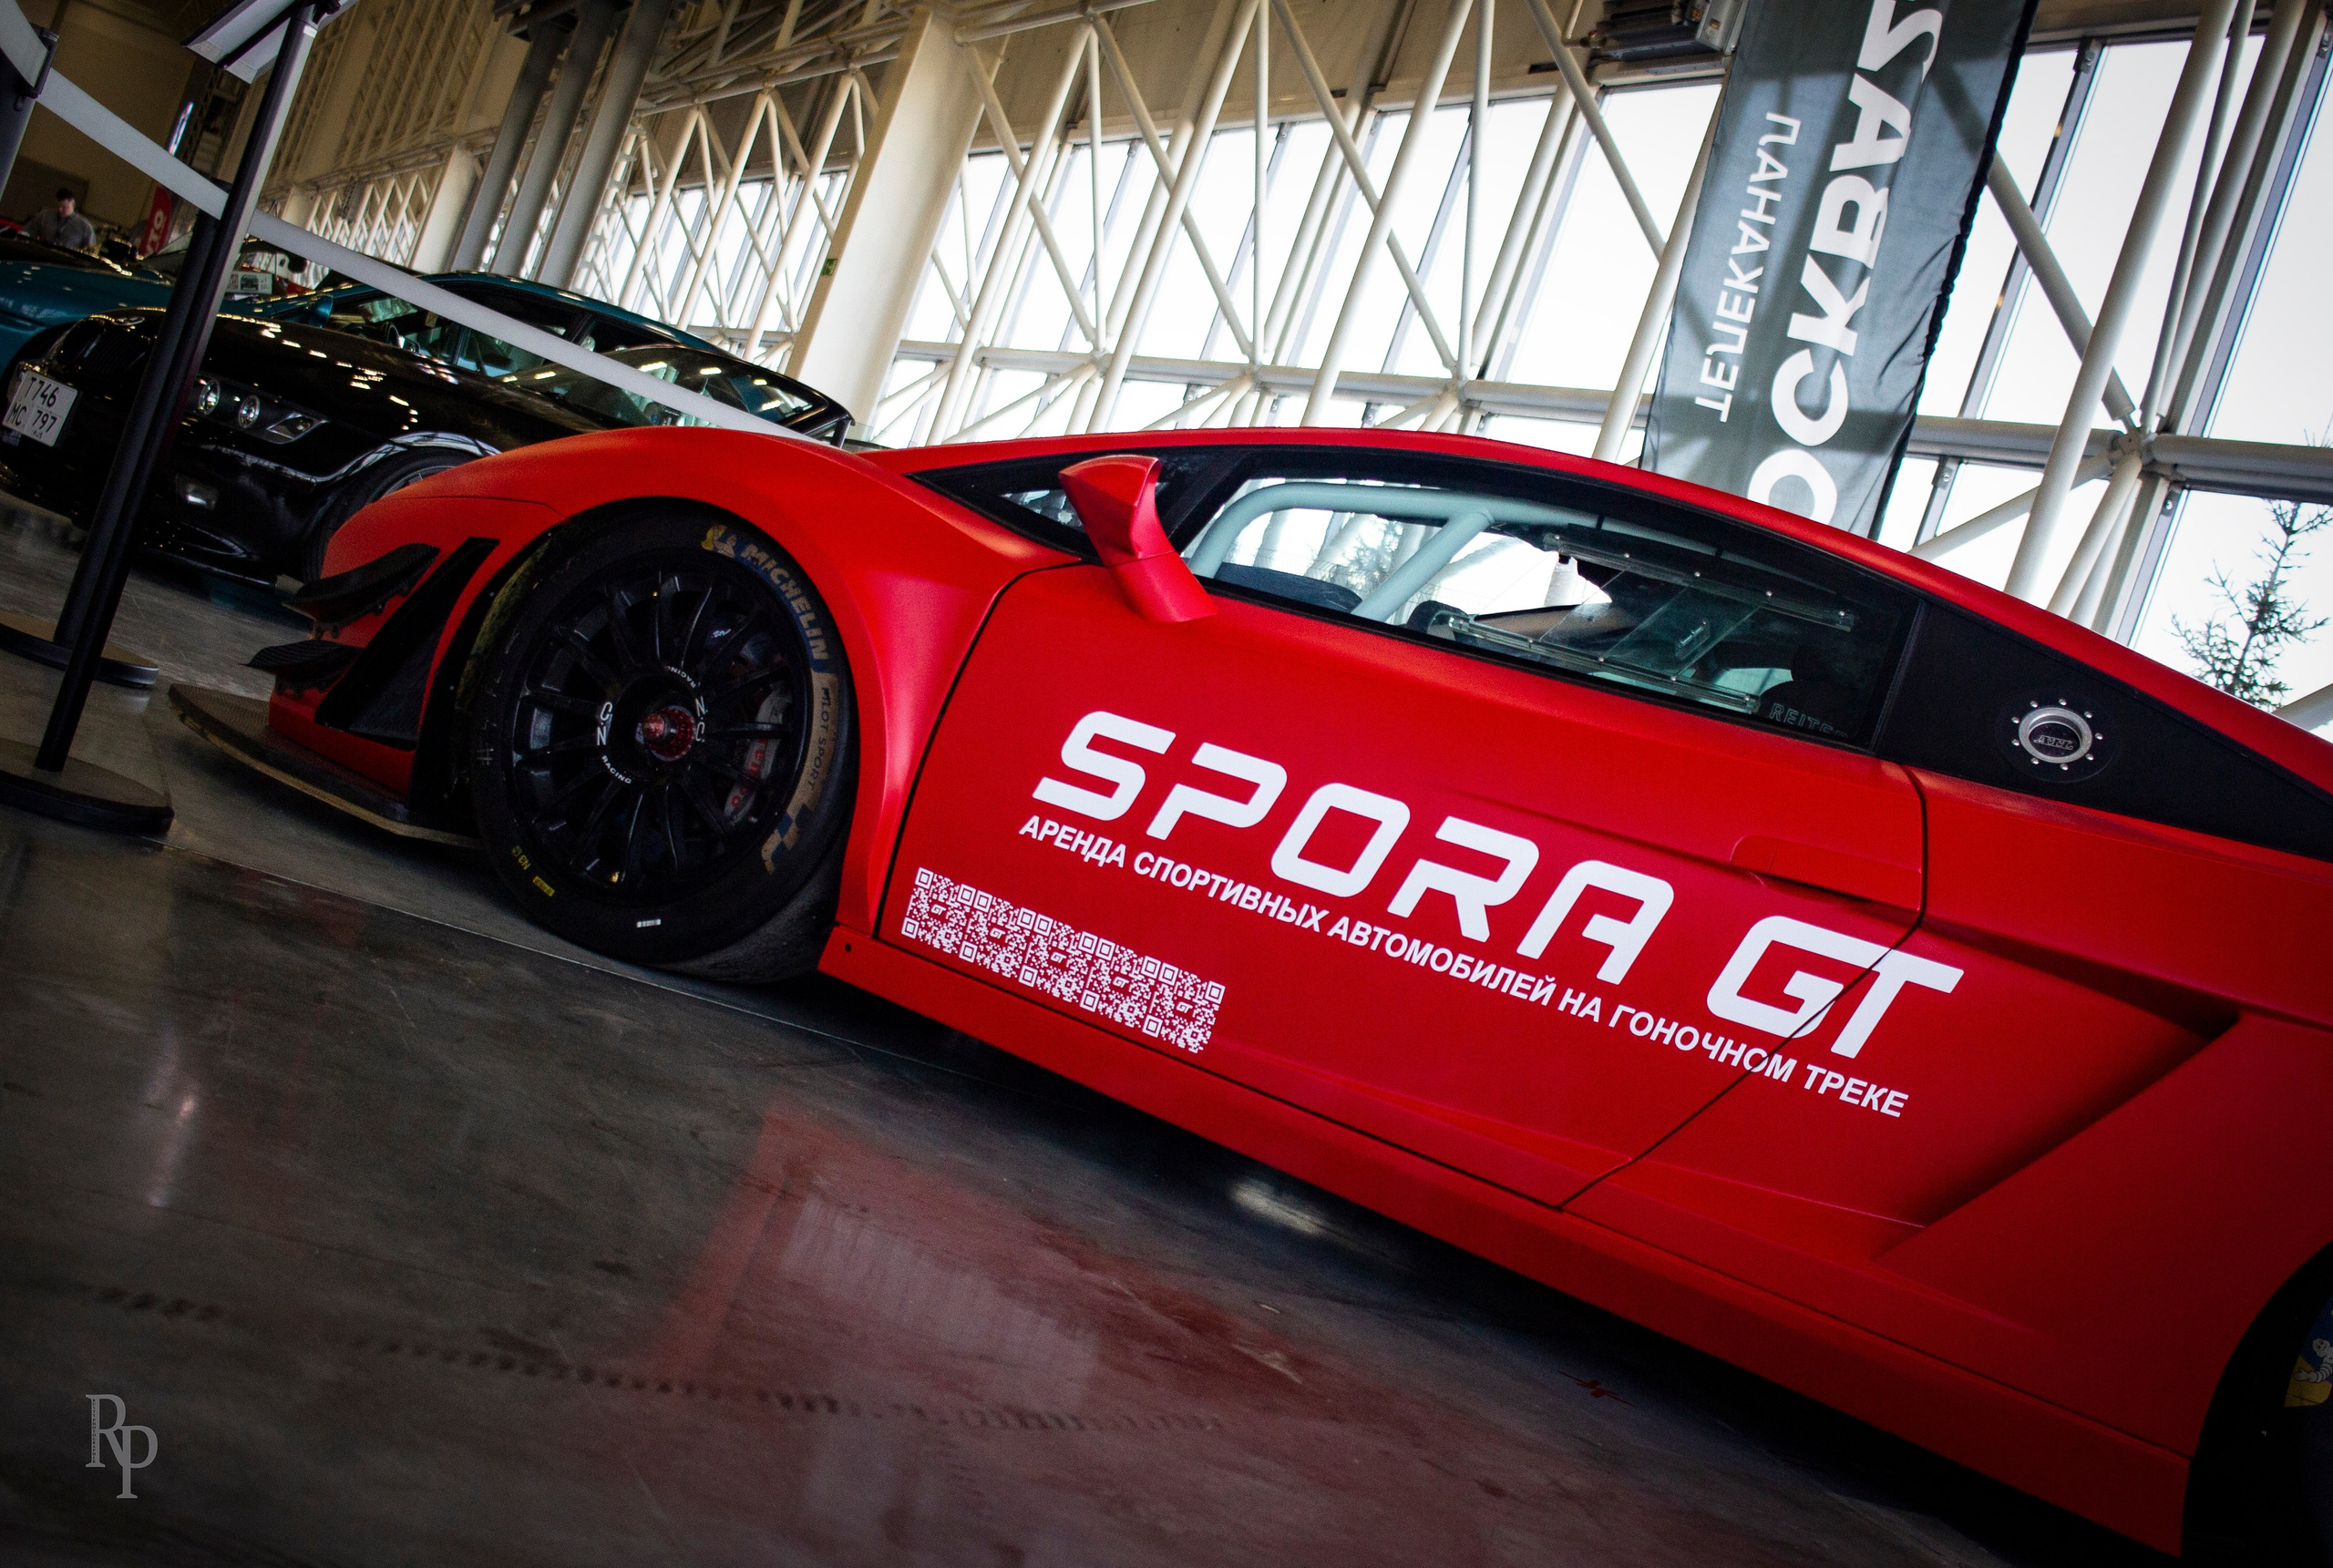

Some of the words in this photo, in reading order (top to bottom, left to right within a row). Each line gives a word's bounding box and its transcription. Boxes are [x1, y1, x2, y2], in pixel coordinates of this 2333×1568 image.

[32, 409, 57, 433] 797
[740, 544, 829, 660] MICHELIN
[601, 755, 632, 784] RACING
[807, 737, 827, 789] SPORT
[1033, 712, 1674, 985] SPORA
[1707, 916, 1964, 1058] GT
[1019, 815, 1125, 867] АРЕНДА
[1135, 852, 1329, 932] СПОРТИВНЫХ
[1327, 917, 1557, 1006] АВТОМОБИЛЕЙ
[1558, 989, 1602, 1022] НА
[1609, 1005, 1797, 1082] ГОНОЧНОМ
[1804, 1064, 1909, 1118] ТРЕКЕ
